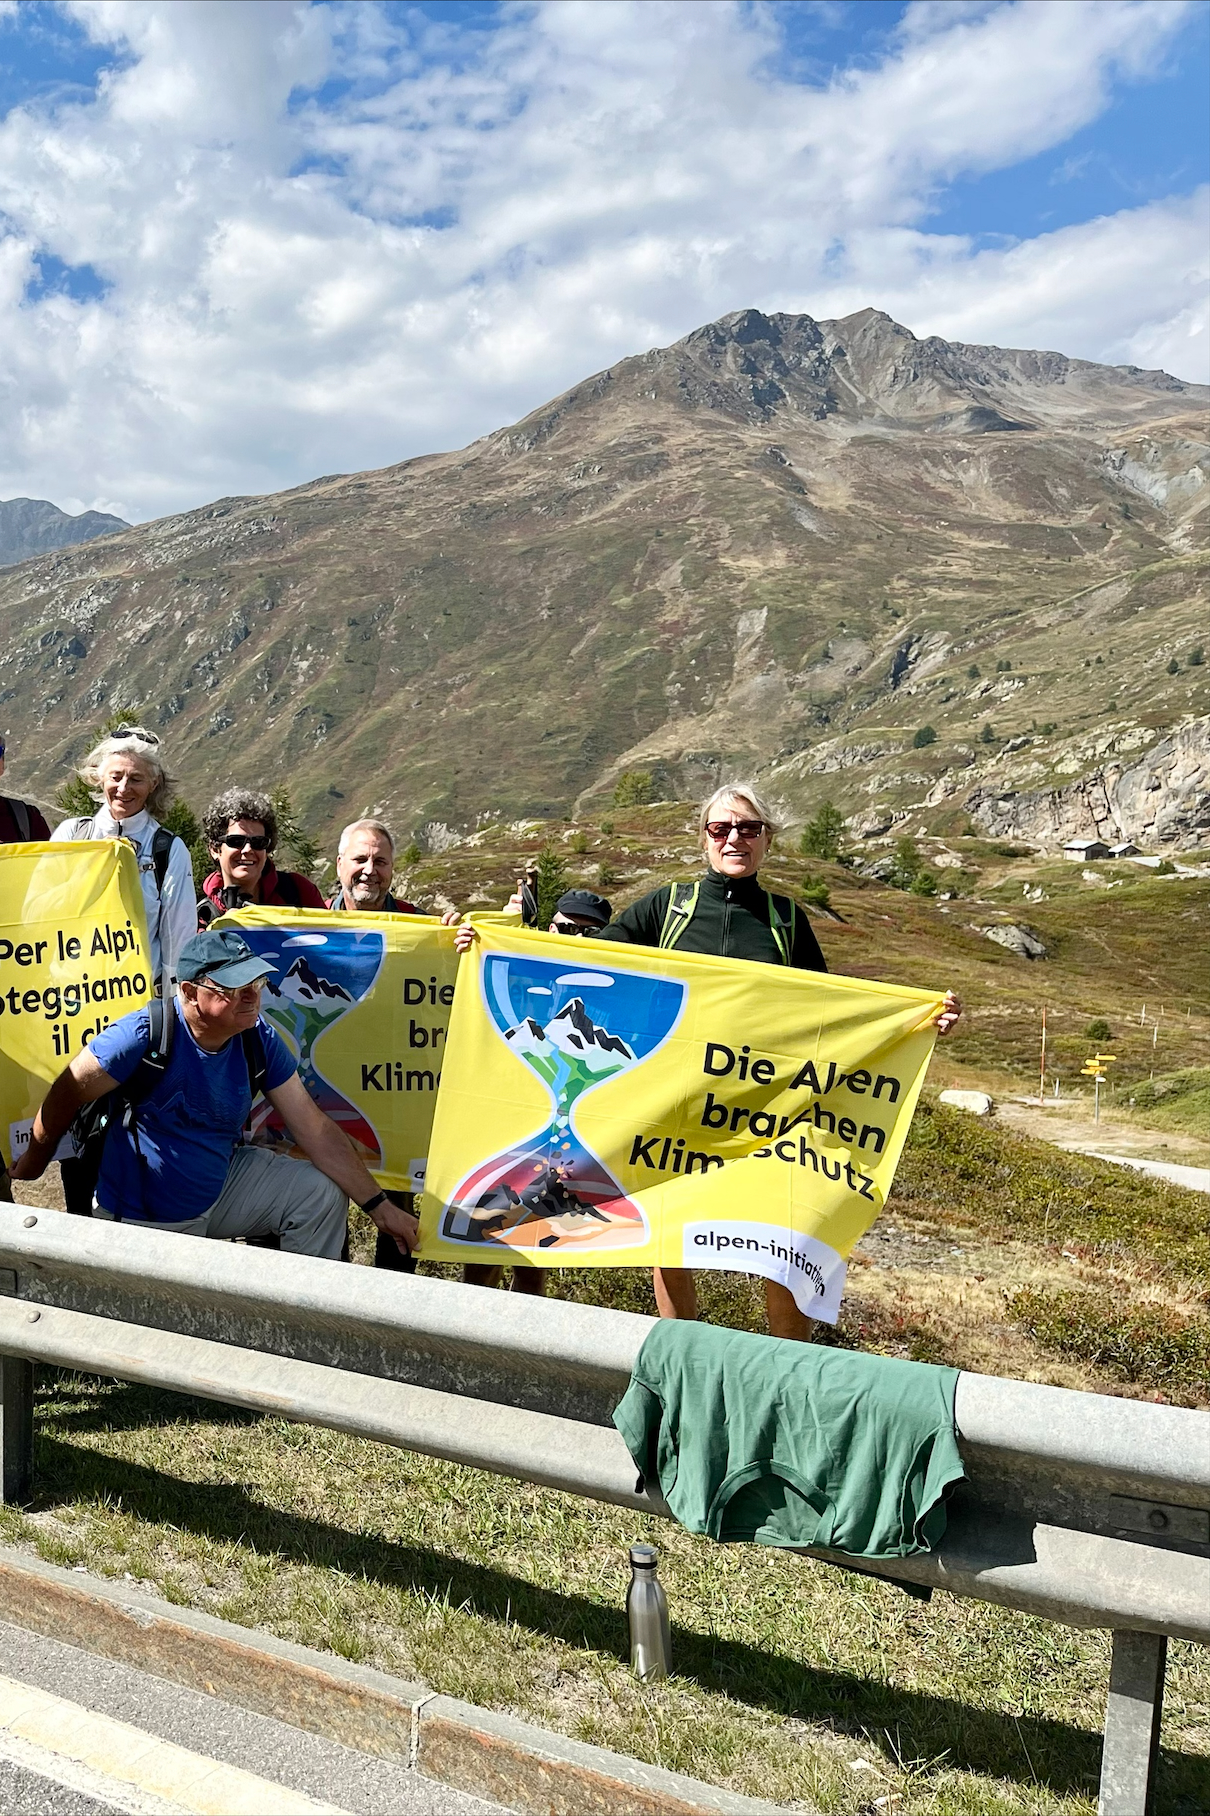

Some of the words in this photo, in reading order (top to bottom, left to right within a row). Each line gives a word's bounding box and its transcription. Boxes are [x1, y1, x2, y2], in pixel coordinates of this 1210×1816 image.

[57, 930, 81, 962] le
[90, 920, 140, 962] Alpi,
[403, 976, 455, 1005] Die
[52, 1023, 70, 1056] il
[703, 1042, 775, 1085] Die
[629, 1135, 875, 1202] Klimschutz
